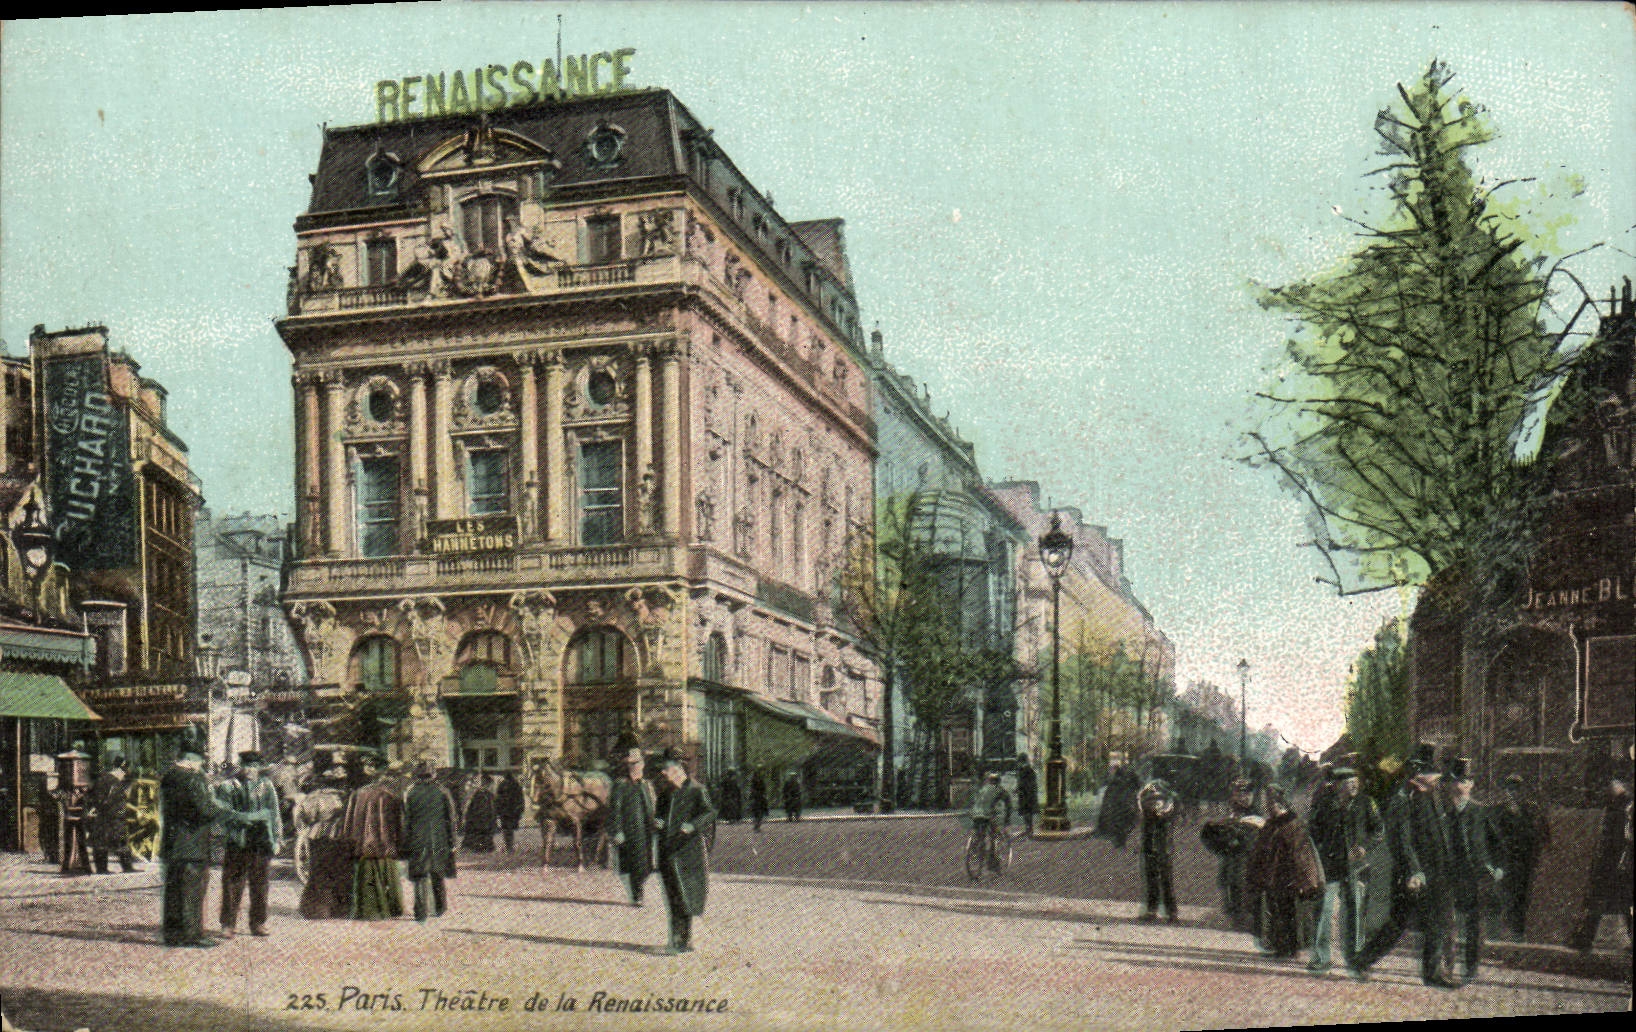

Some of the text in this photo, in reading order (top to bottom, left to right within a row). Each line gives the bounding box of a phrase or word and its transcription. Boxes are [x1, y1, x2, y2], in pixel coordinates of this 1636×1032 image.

[375, 47, 637, 123] RENAISSANCE
[456, 521, 485, 533] LES
[1521, 575, 1635, 609] JEANNE BL
